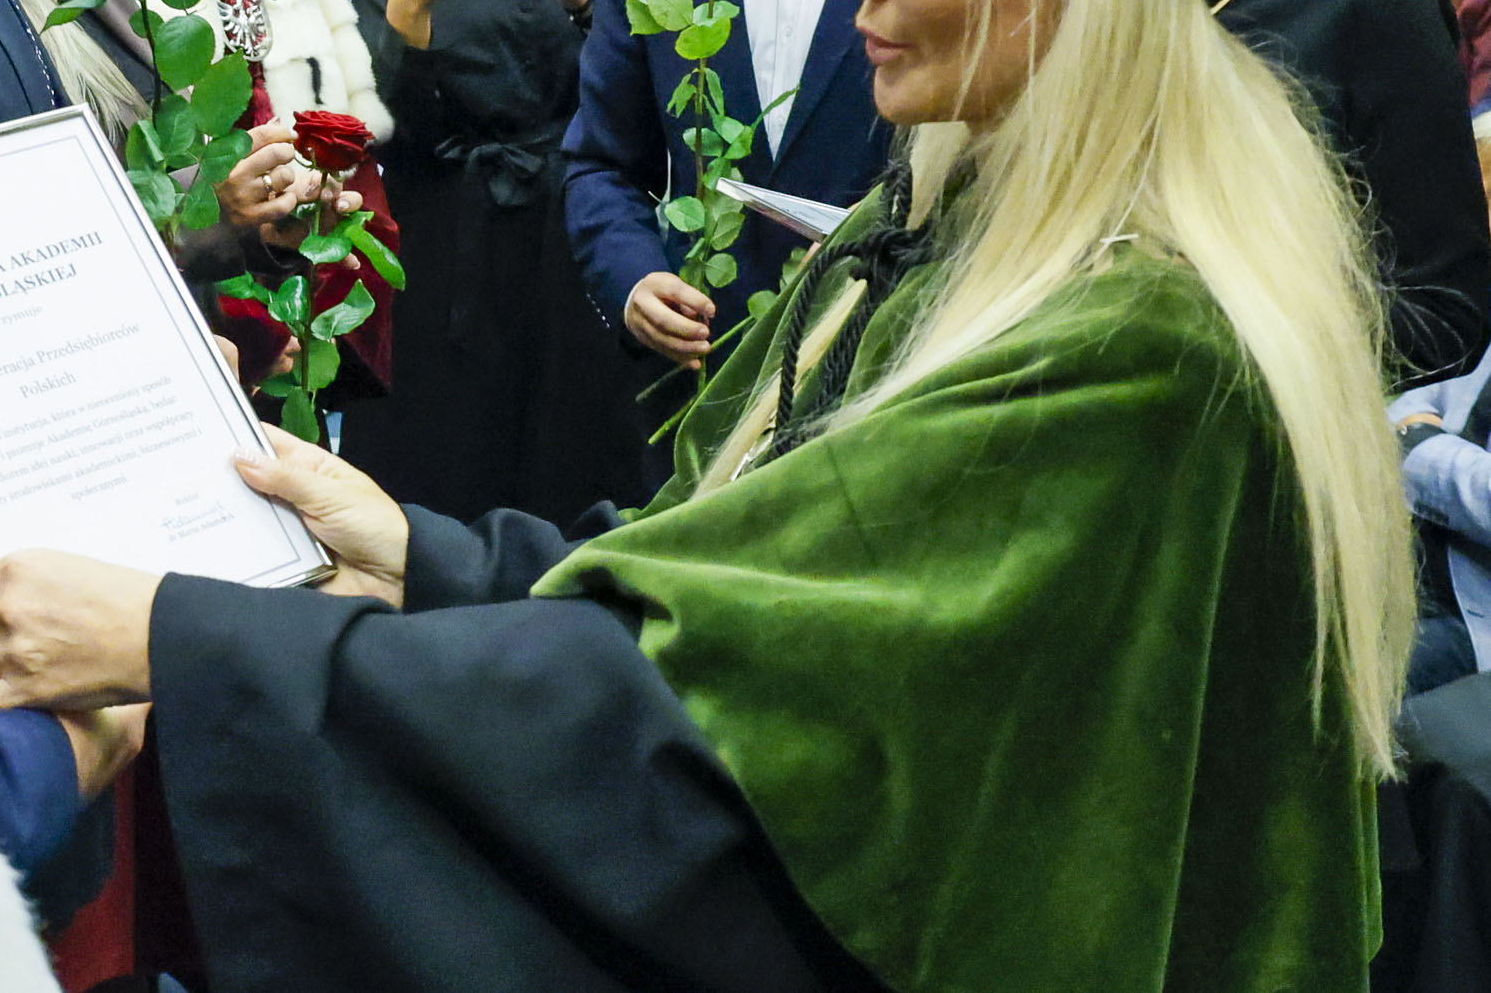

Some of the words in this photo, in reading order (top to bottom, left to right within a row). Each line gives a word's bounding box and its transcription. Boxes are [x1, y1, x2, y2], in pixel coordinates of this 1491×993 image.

[10, 231, 102, 270] AKADEMII
[35, 323, 140, 364] Przedsiębiorców
[18, 371, 77, 399] Polskich
